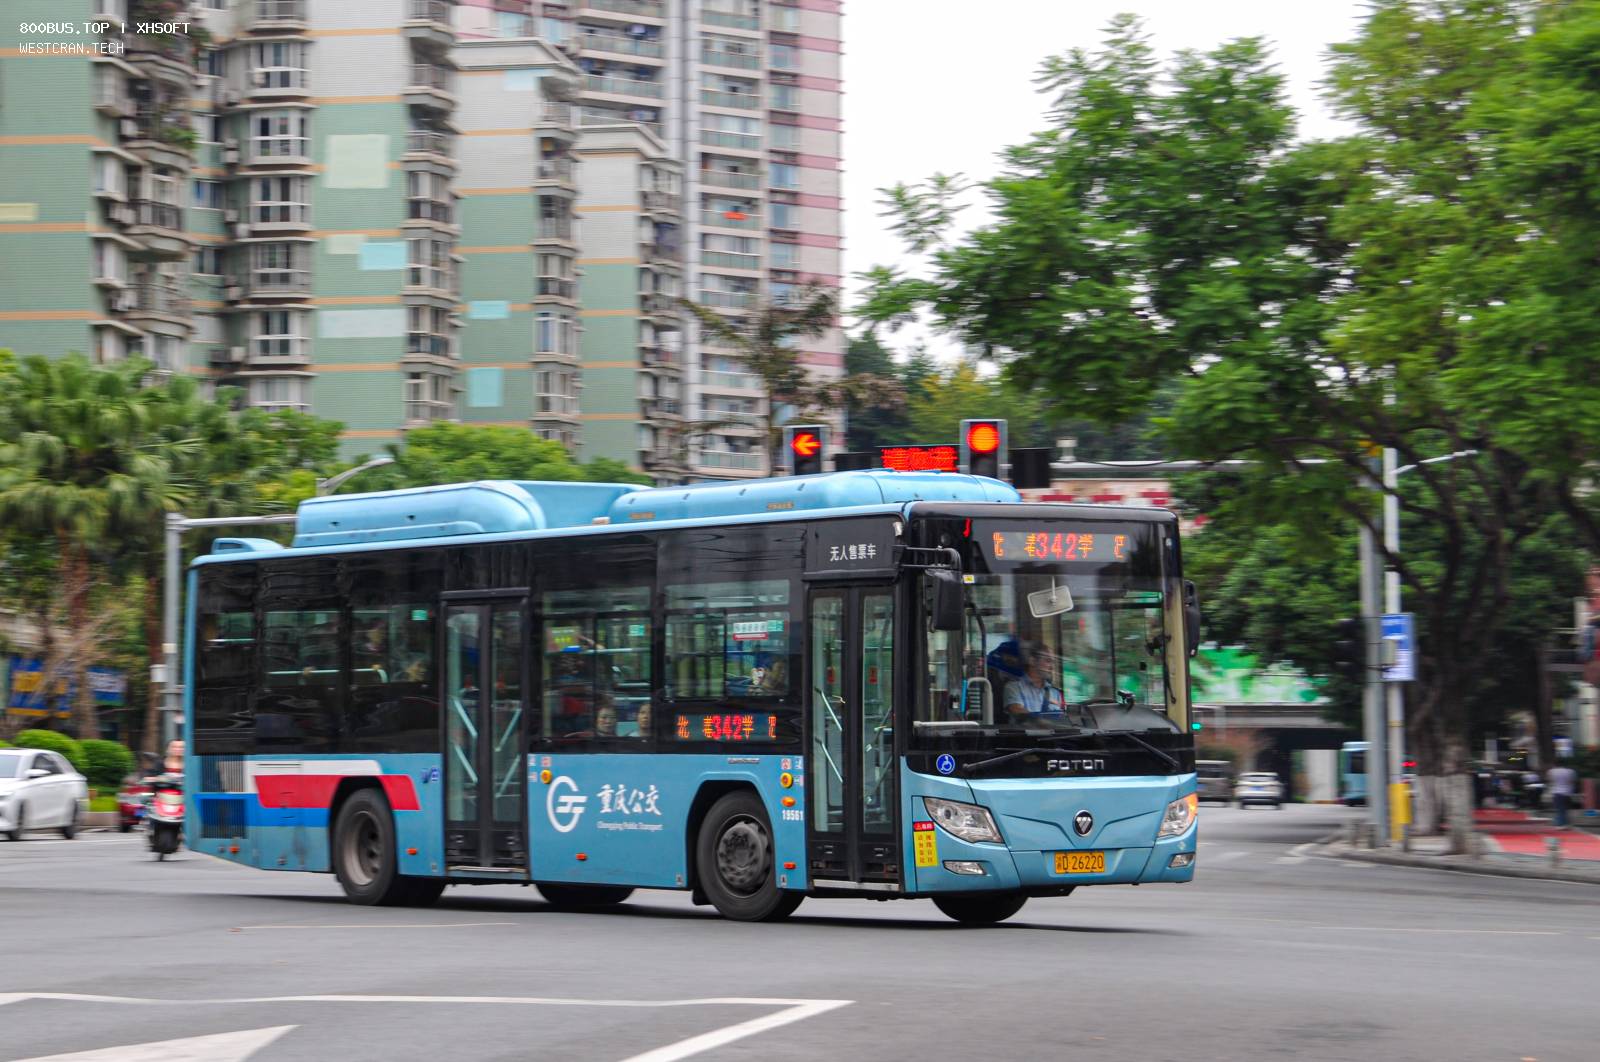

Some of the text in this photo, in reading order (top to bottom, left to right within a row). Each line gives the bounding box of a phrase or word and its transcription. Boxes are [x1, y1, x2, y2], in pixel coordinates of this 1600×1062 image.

[829, 543, 877, 561] 无人售票车
[1047, 759, 1105, 771] FOTON
[596, 783, 662, 816] 重庆公交
